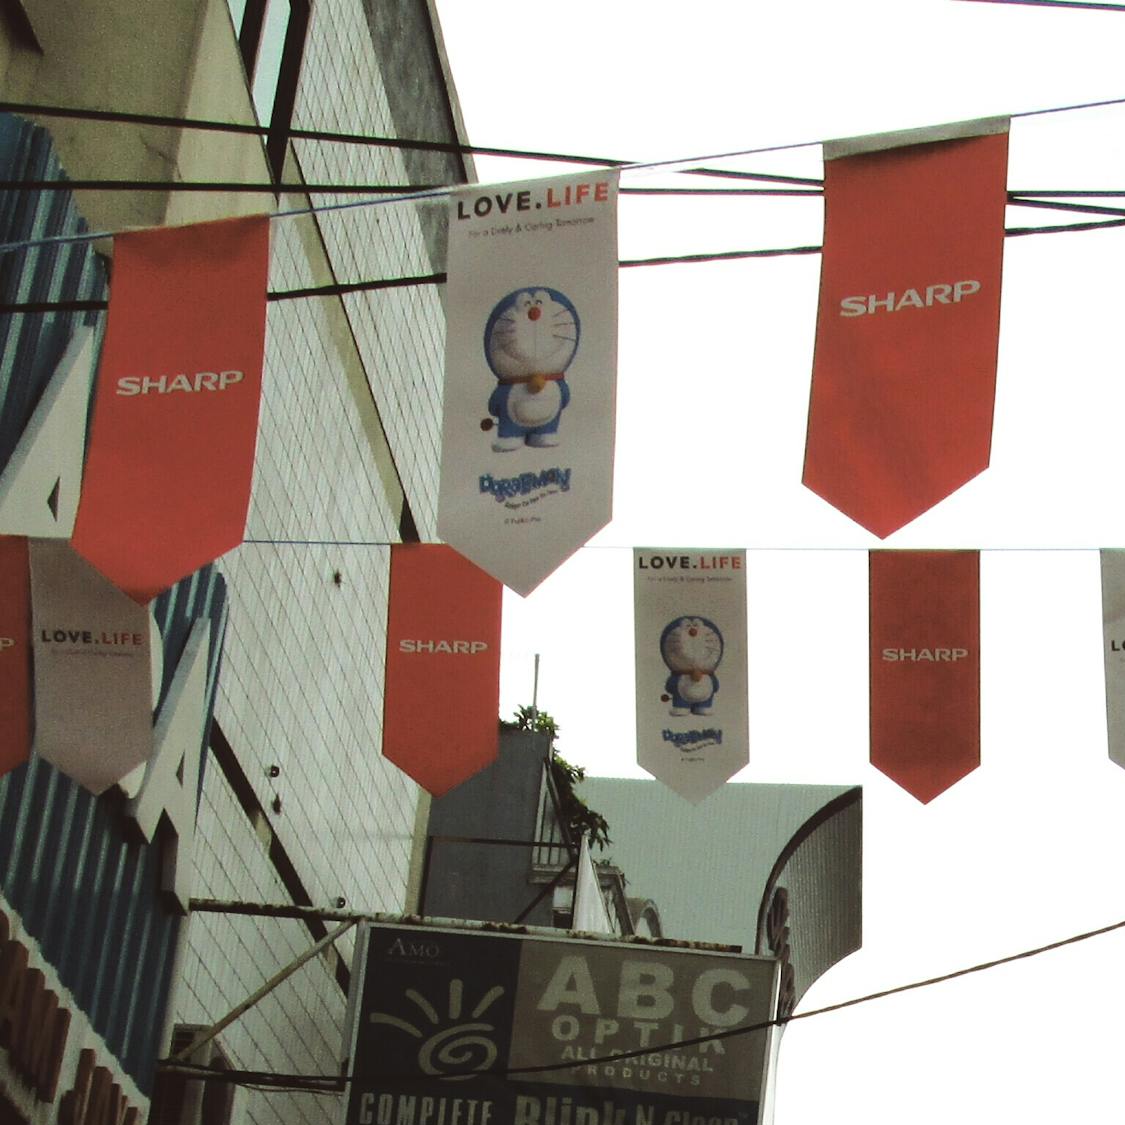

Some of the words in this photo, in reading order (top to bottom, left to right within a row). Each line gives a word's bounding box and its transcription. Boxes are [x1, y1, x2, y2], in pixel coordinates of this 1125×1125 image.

[458, 182, 608, 220] LOVE.LIFE
[839, 279, 981, 318] SHARP
[116, 370, 243, 396] SHARP
[639, 556, 742, 570] LOVE.LIFE
[42, 630, 143, 646] LOVE.LIFE
[399, 638, 488, 655] SHARP
[882, 647, 968, 661] SHARP
[537, 956, 750, 1027] ABC
[552, 1015, 726, 1055] OPTIK
[561, 1046, 597, 1060] ALL
[611, 1049, 714, 1072] ORIGINAL
